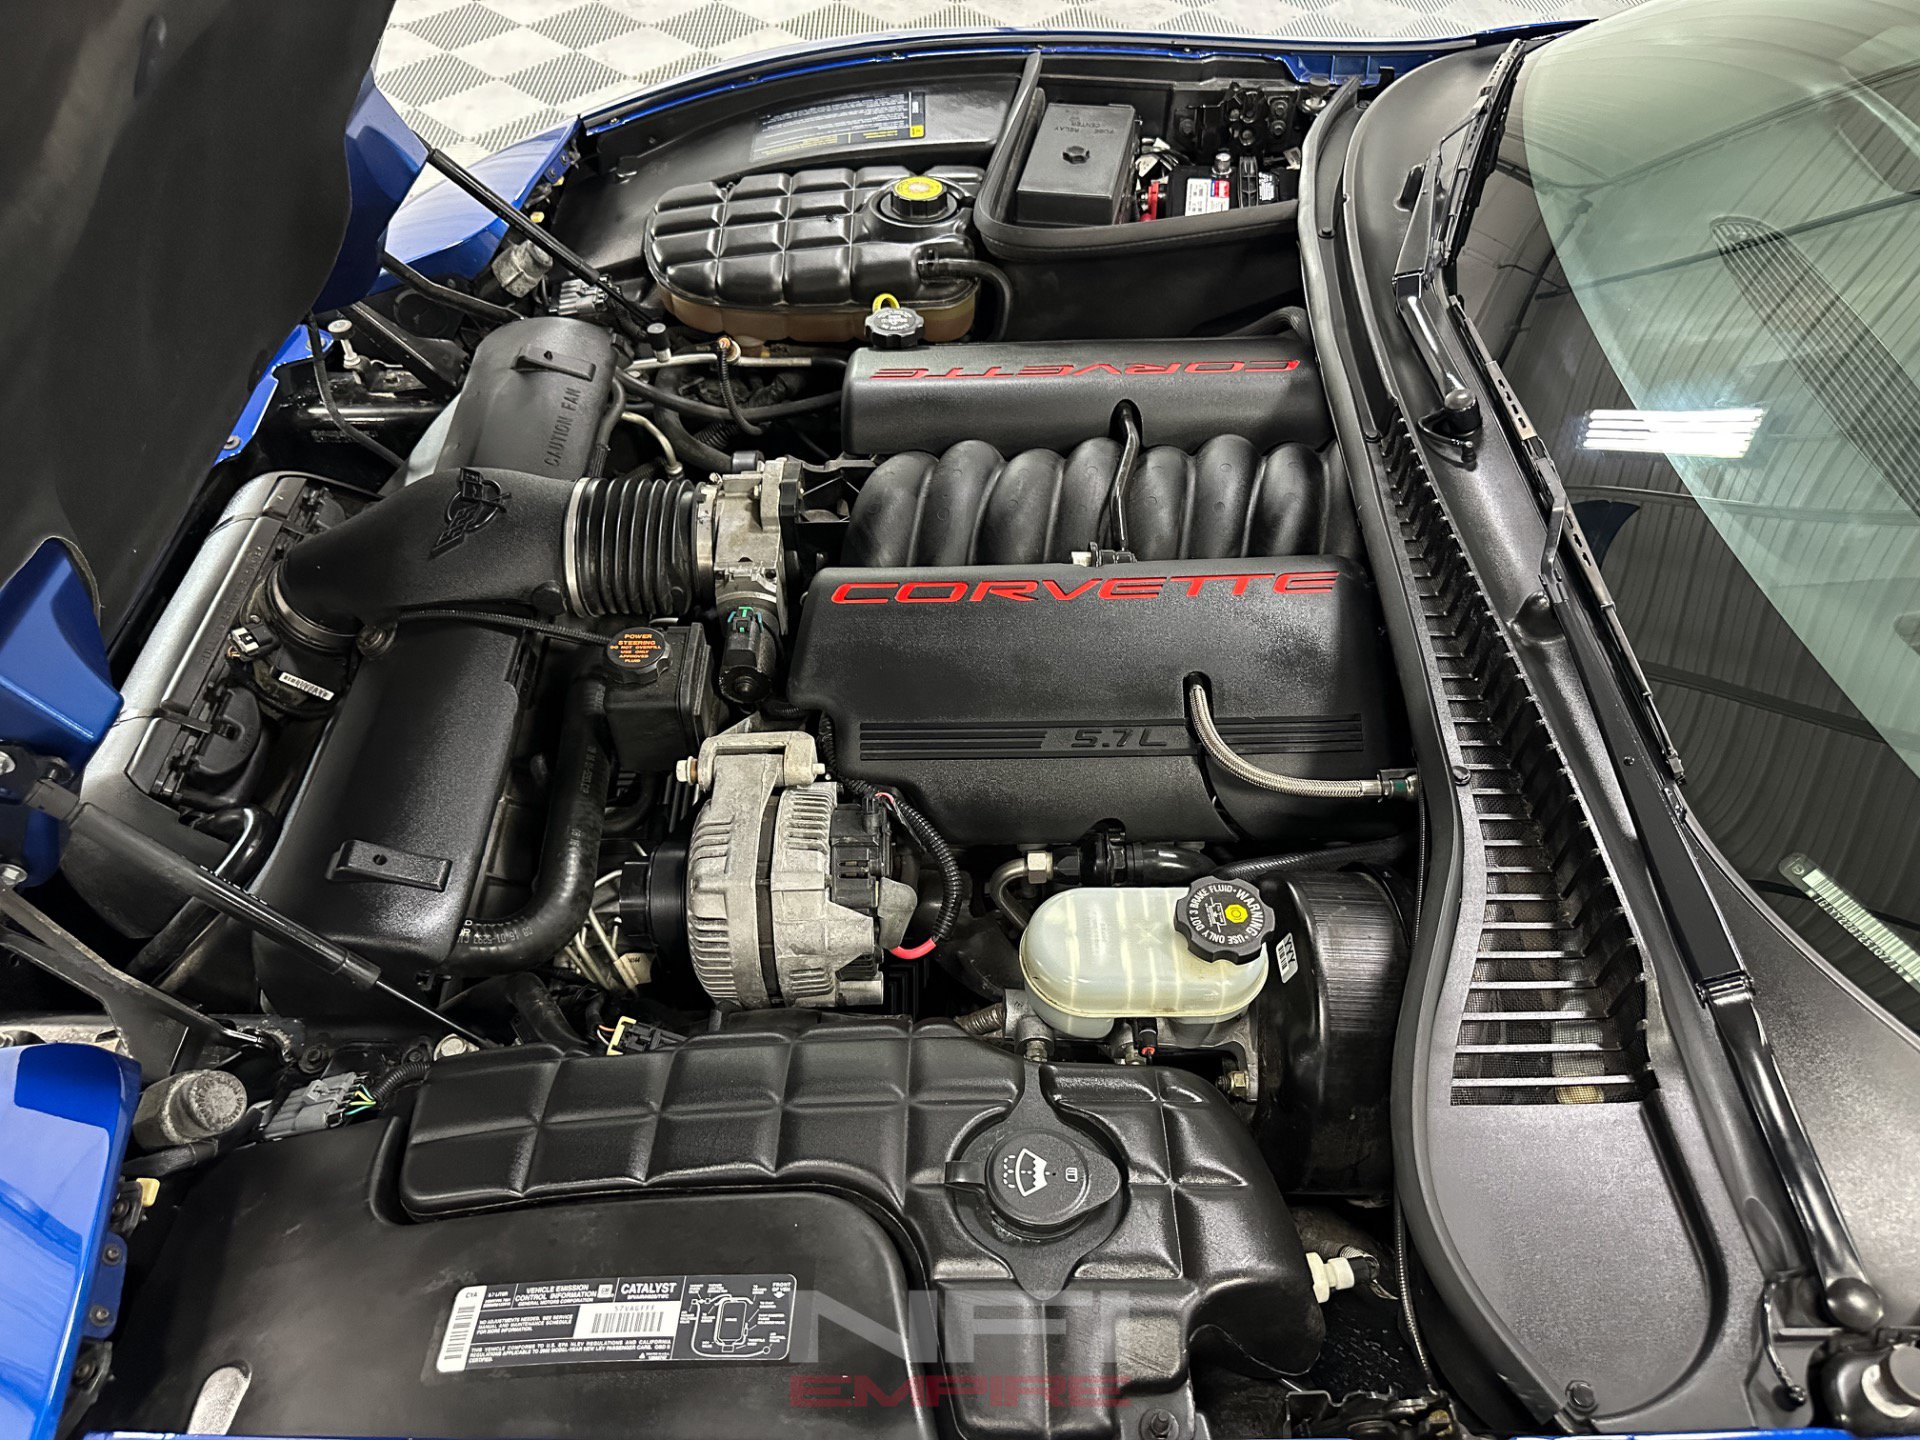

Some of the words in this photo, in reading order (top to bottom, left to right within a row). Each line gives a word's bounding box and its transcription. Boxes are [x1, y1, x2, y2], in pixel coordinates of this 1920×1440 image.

[870, 360, 1300, 380] CORVETTE
[544, 416, 573, 467] CAUTION
[561, 387, 582, 411] FAN
[831, 571, 1340, 604] CORVETTE
[1070, 728, 1167, 748] 5.7L
[1208, 883, 1234, 894] FLUID
[1189, 888, 1209, 910] BRAKE
[1234, 888, 1265, 937] WARNING
[1189, 915, 1206, 932] DOT
[1202, 929, 1226, 944] ONLY
[1226, 933, 1246, 945] USE
[515, 1293, 547, 1302] CONTROL
[551, 1291, 597, 1300] INFORMATION
[526, 1285, 555, 1294] VEHICLE
[556, 1284, 589, 1293] EMISSION
[620, 1282, 677, 1294] CATALYST
